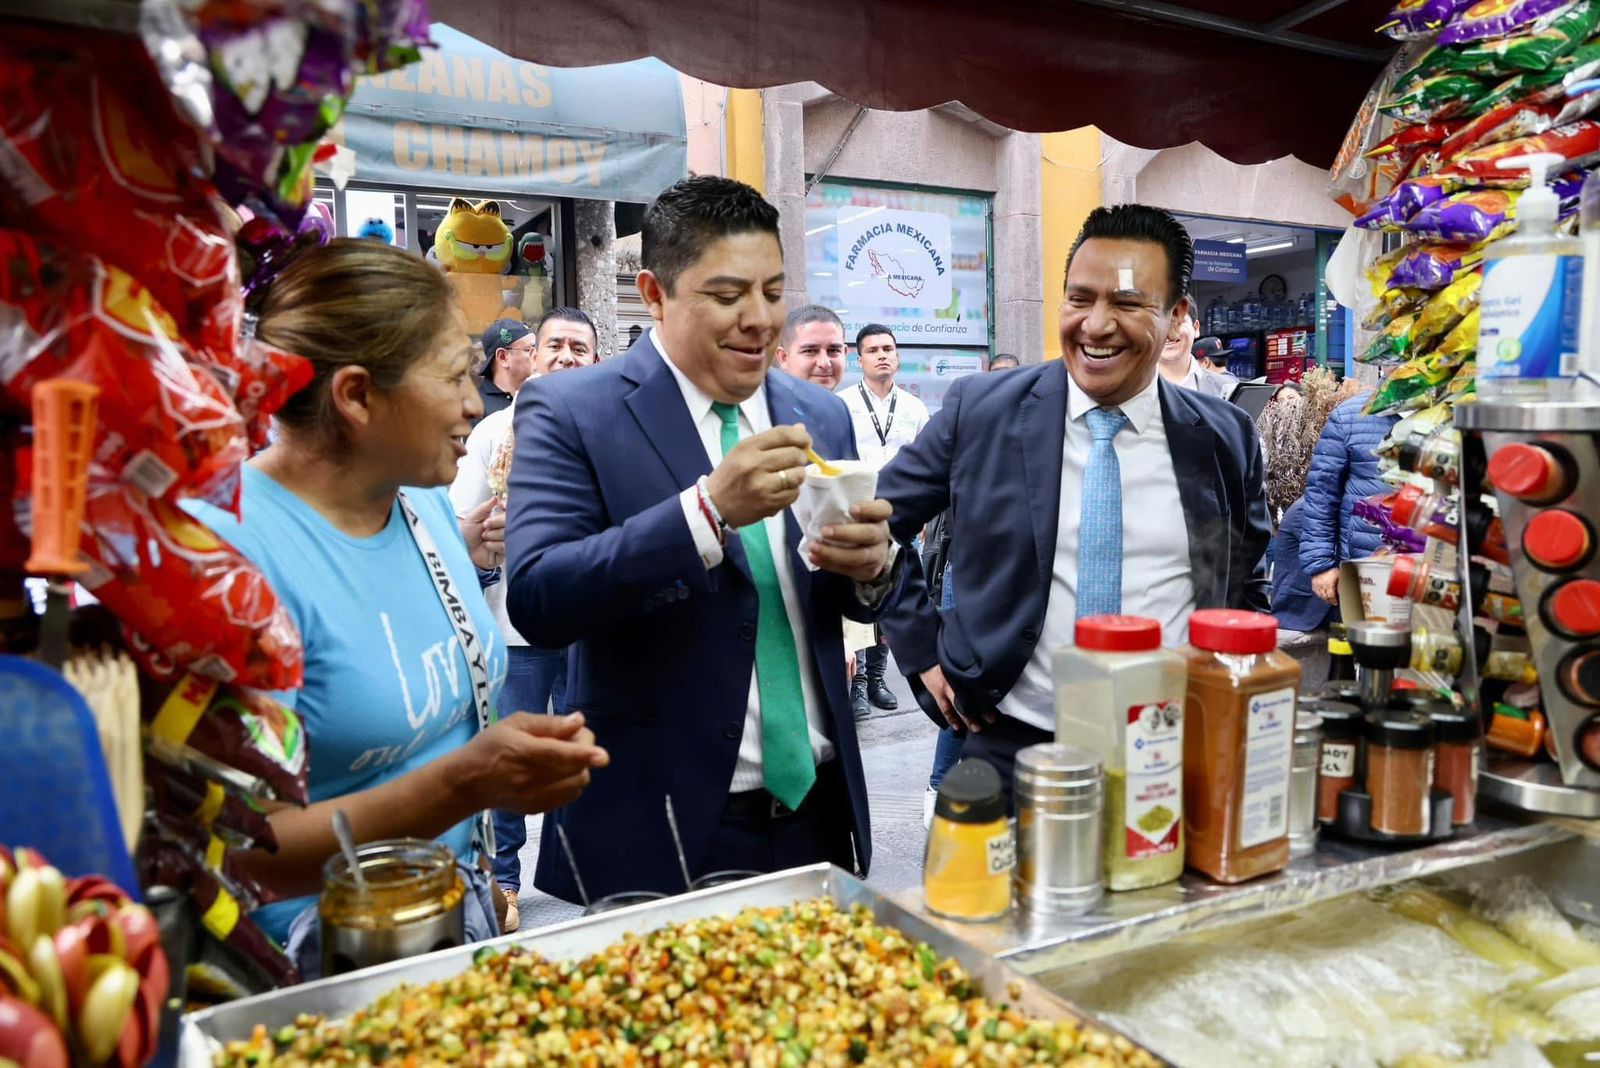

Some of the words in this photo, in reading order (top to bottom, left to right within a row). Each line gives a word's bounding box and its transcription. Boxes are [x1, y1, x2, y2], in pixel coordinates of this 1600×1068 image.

[393, 120, 606, 187] CHAMOY
[845, 222, 893, 271] FARMACIA
[896, 222, 945, 276] MEXICANA
[911, 322, 923, 333] de
[924, 322, 968, 334] Confianza
[426, 550, 476, 649] BIMBA
